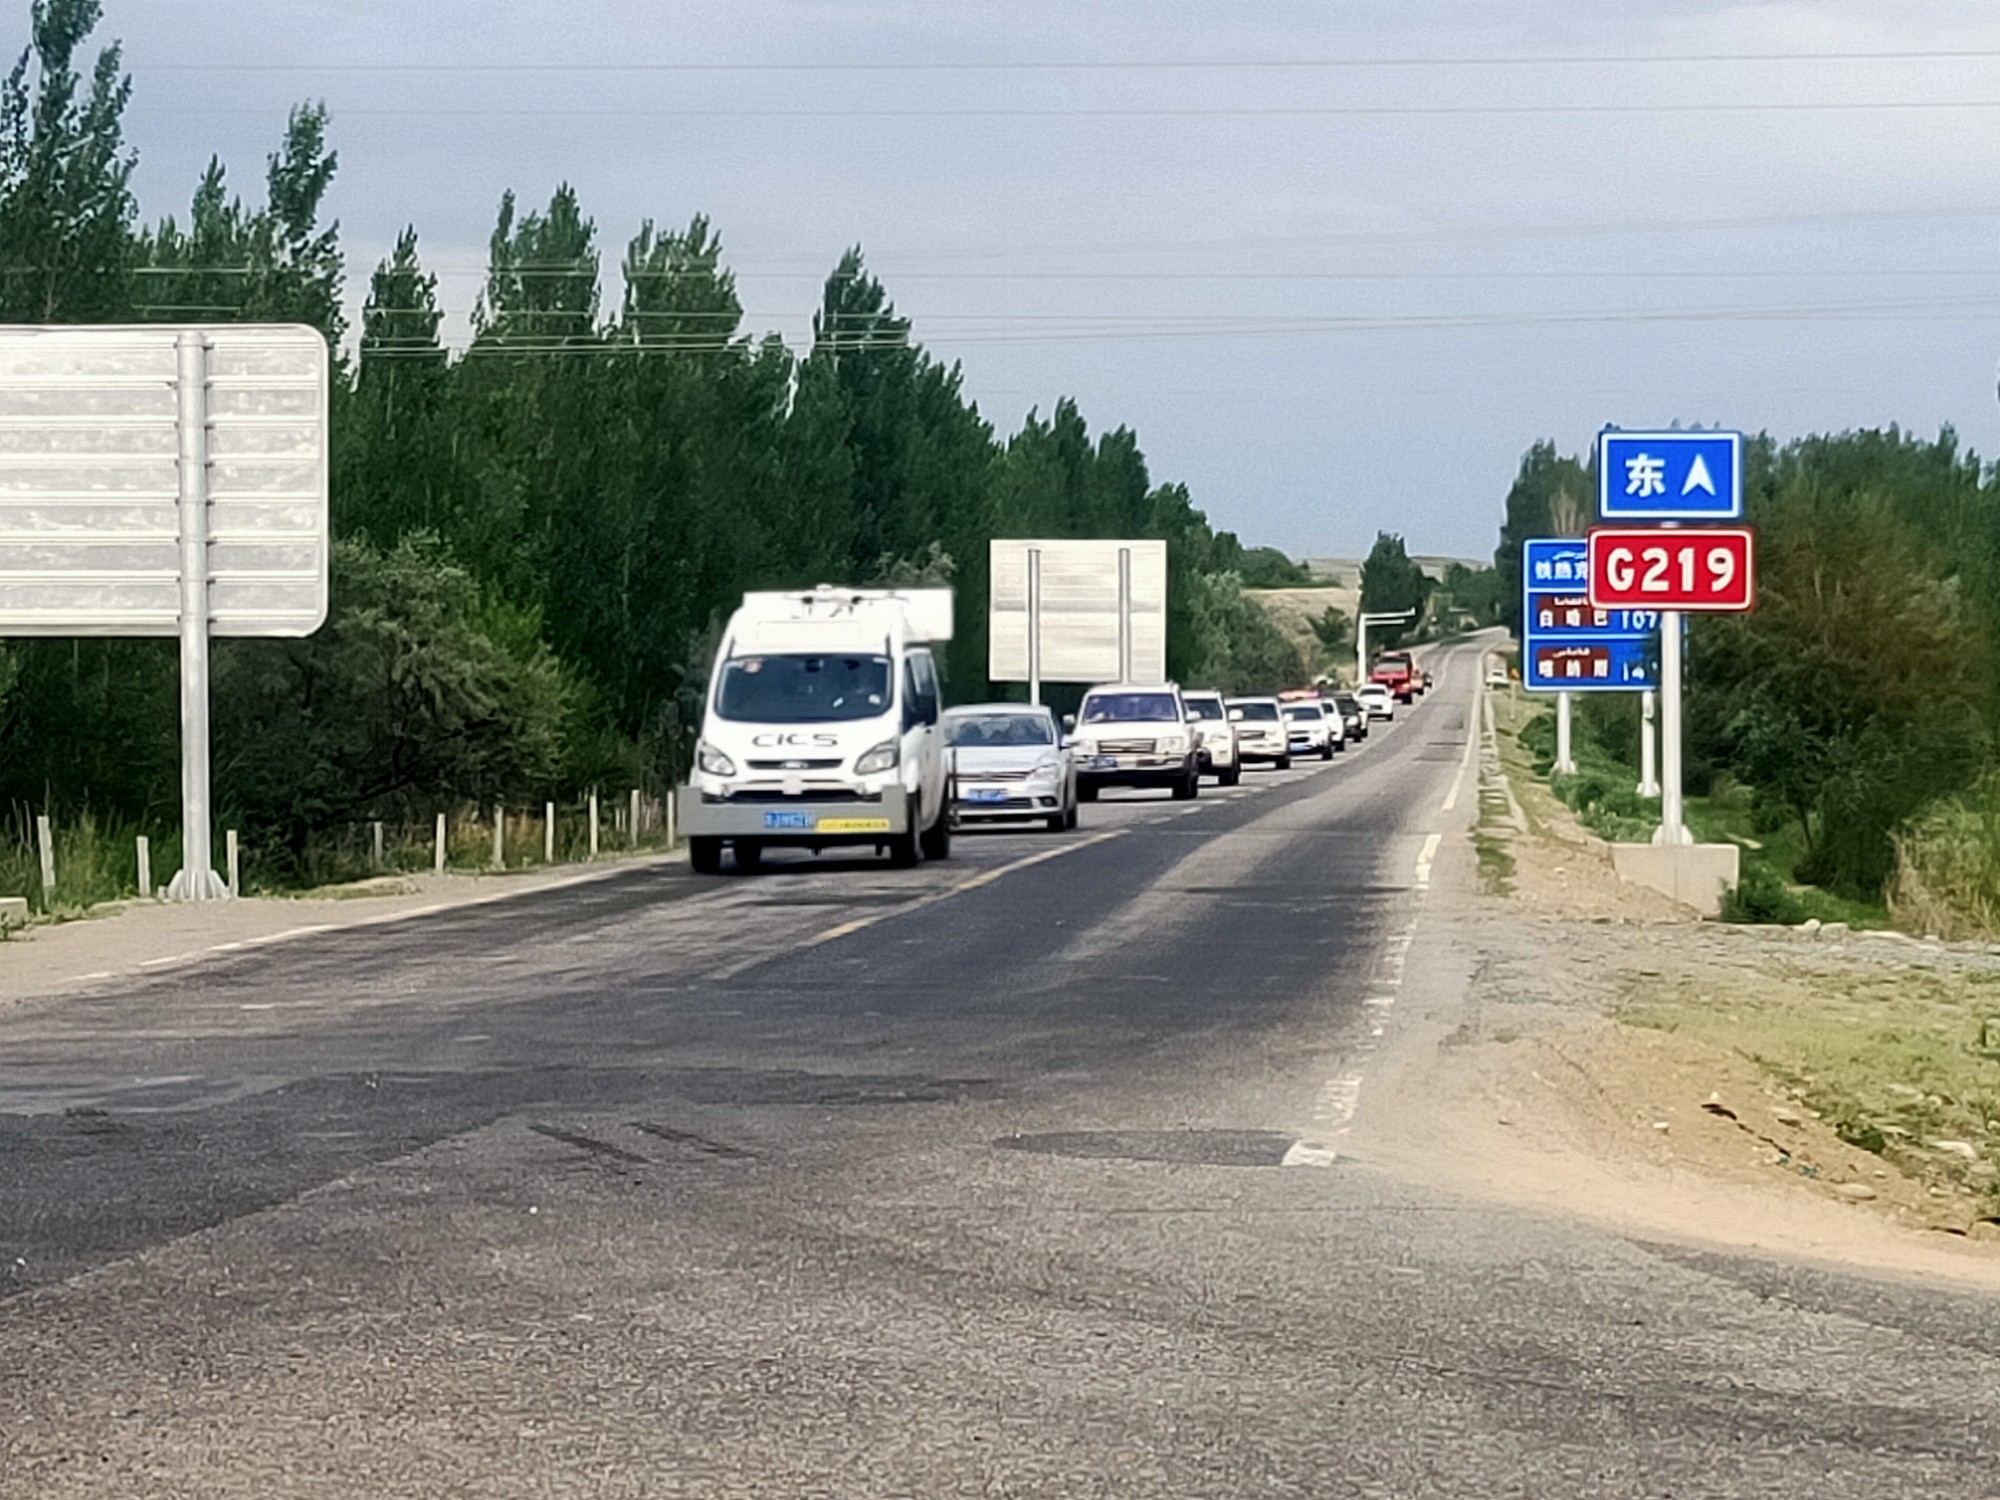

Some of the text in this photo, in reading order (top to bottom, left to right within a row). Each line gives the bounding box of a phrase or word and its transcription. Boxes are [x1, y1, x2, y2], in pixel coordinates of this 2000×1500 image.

[1624, 453, 1666, 498] 东
[1606, 547, 1735, 593] G219
[752, 732, 839, 748] CICS
